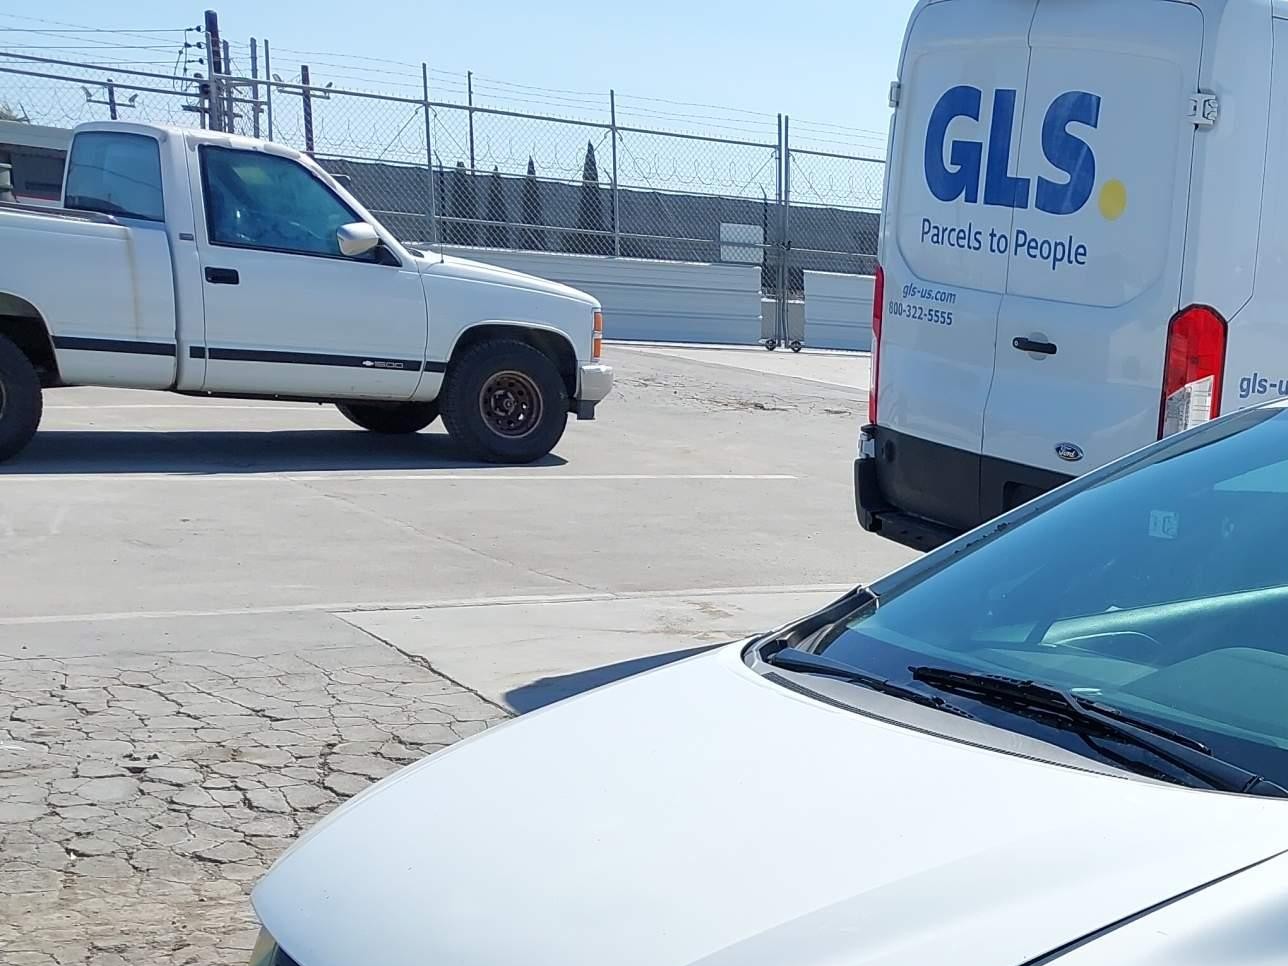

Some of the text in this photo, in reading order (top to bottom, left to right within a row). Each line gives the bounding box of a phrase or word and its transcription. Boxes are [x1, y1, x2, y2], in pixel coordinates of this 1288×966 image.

[921, 218, 1088, 270] Parcels to People
[902, 282, 957, 304] gls-us.com
[888, 300, 953, 326] 800-322-5555
